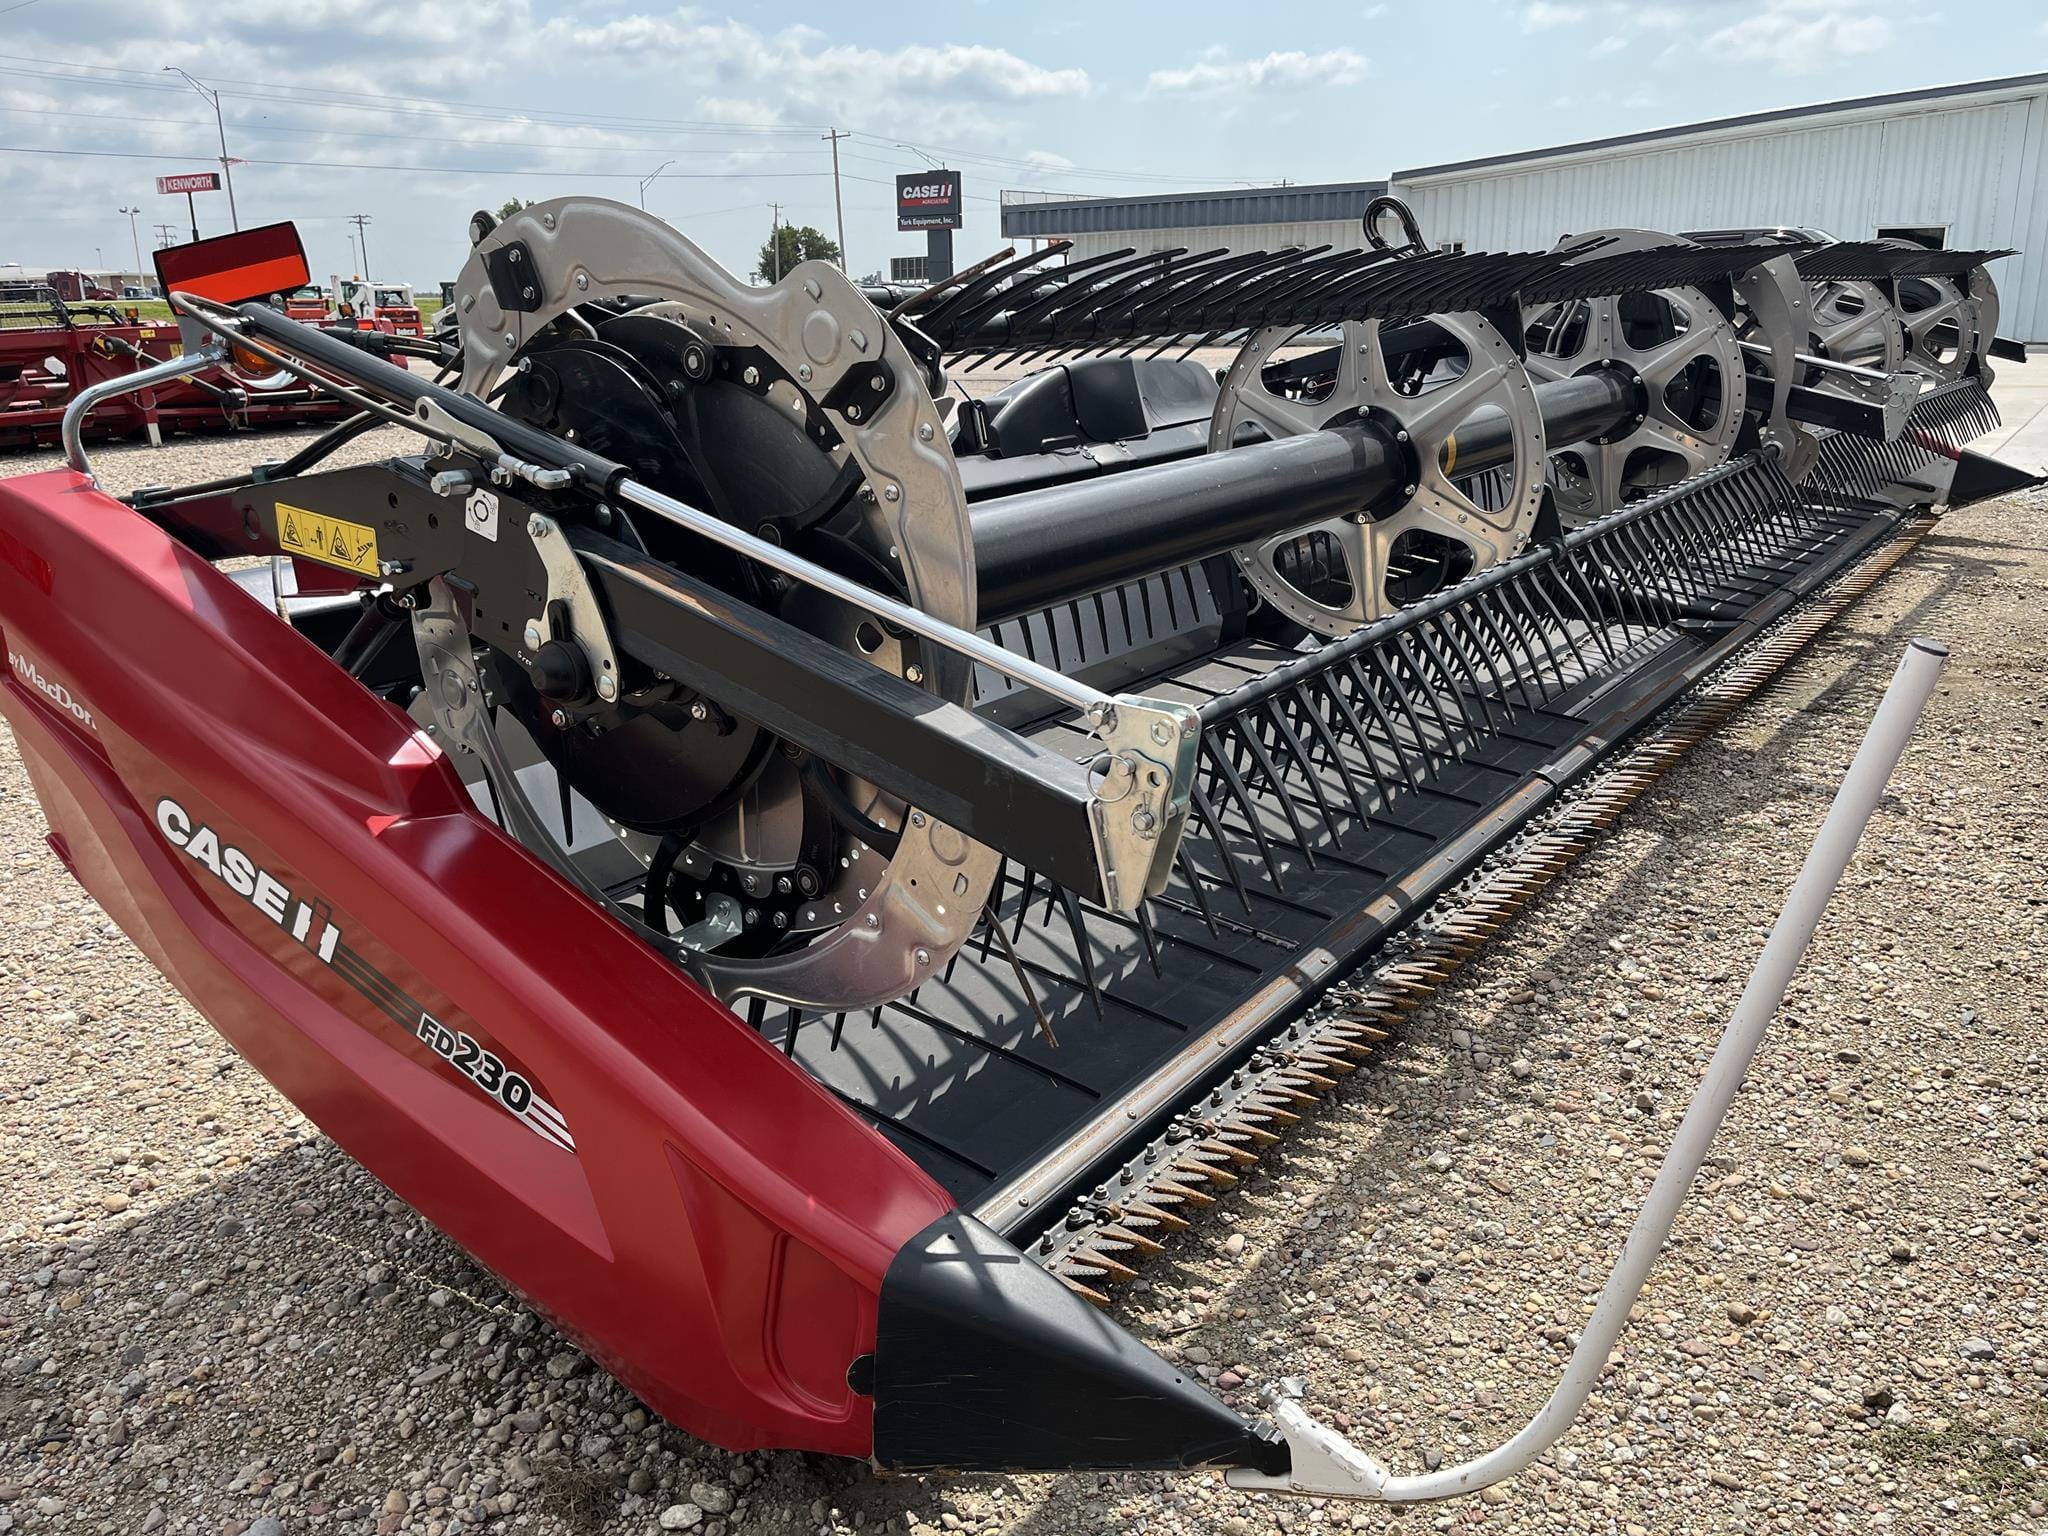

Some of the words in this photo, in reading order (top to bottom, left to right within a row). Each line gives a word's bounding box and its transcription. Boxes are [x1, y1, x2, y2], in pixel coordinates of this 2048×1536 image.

[166, 175, 213, 190] KENWORTH
[902, 185, 939, 199] CASE
[922, 197, 949, 205] AGRICULTURE
[900, 218, 912, 226] York
[913, 217, 943, 227] Equipment,
[943, 216, 954, 224] Inc.
[396, 327, 417, 336] Bobcat
[157, 799, 290, 925] CASE
[416, 1012, 533, 1115] FD230
